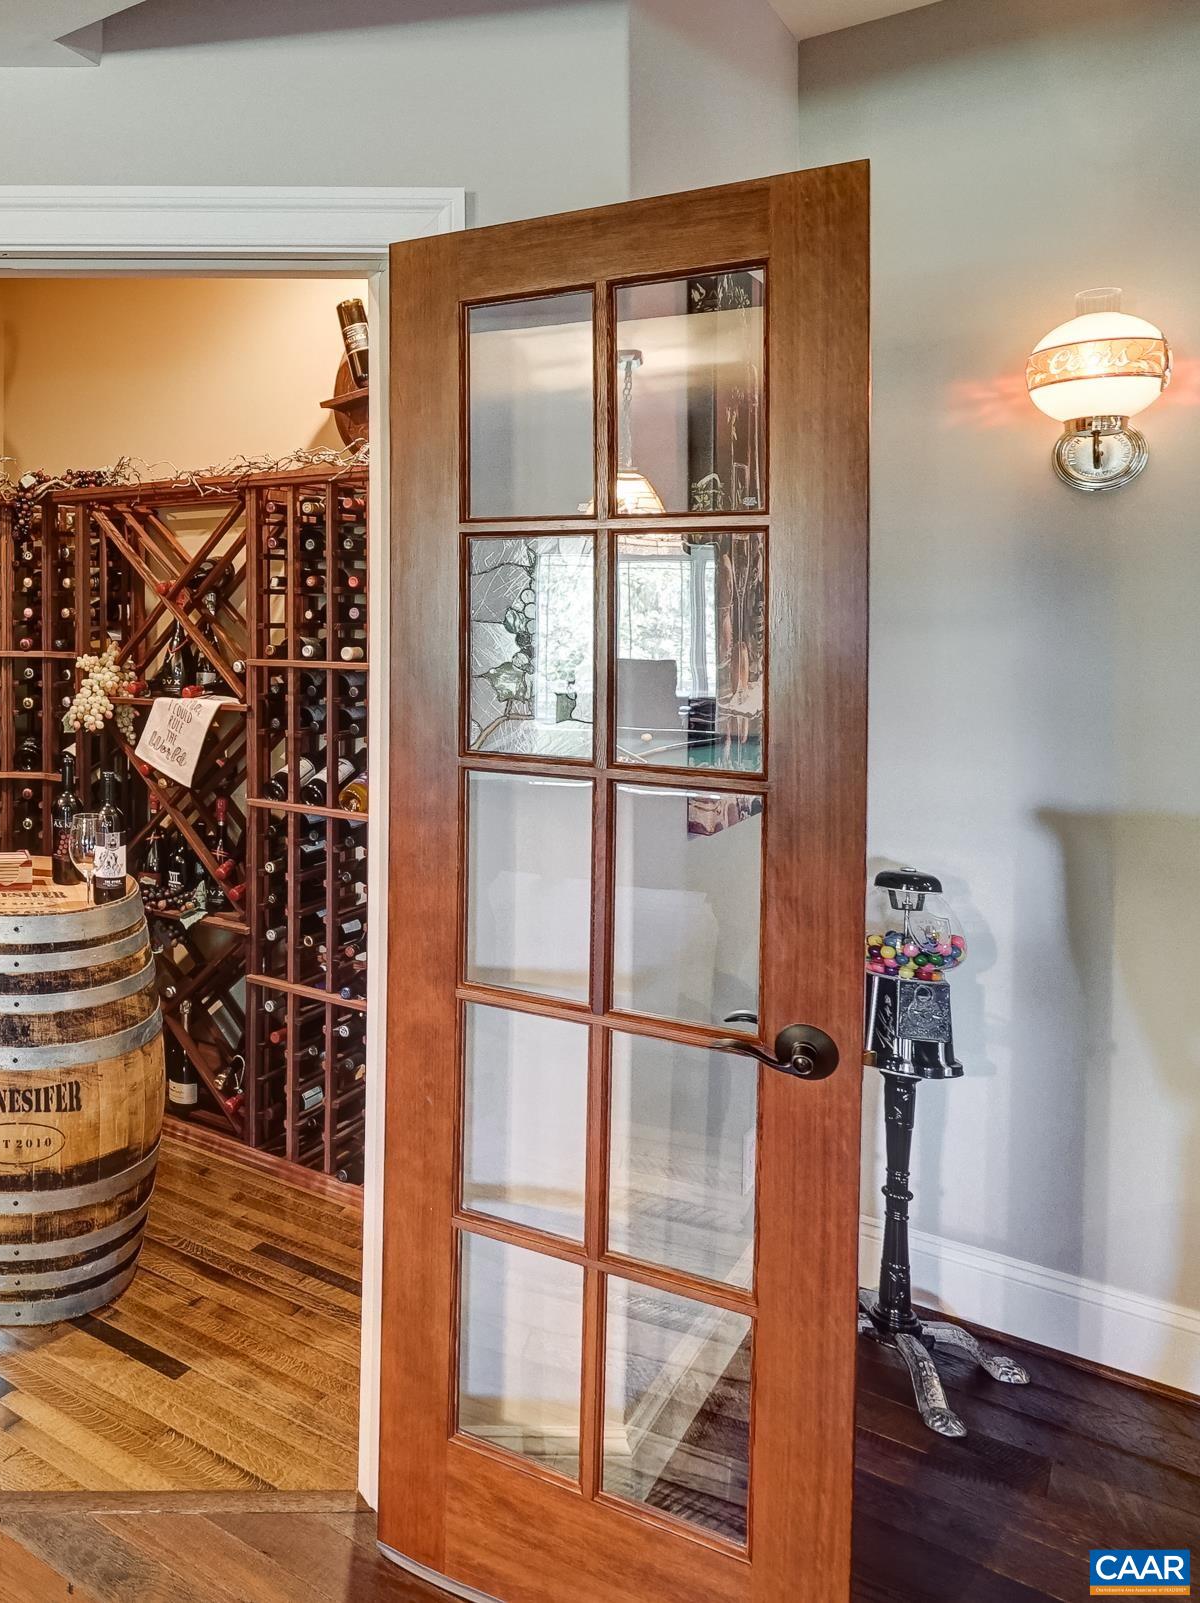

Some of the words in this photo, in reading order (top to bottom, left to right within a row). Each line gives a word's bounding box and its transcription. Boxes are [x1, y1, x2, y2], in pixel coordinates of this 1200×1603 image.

[172, 702, 193, 724] COULD
[168, 715, 184, 734] RULE
[166, 729, 178, 746] THE
[15, 1137, 52, 1149] 2010
